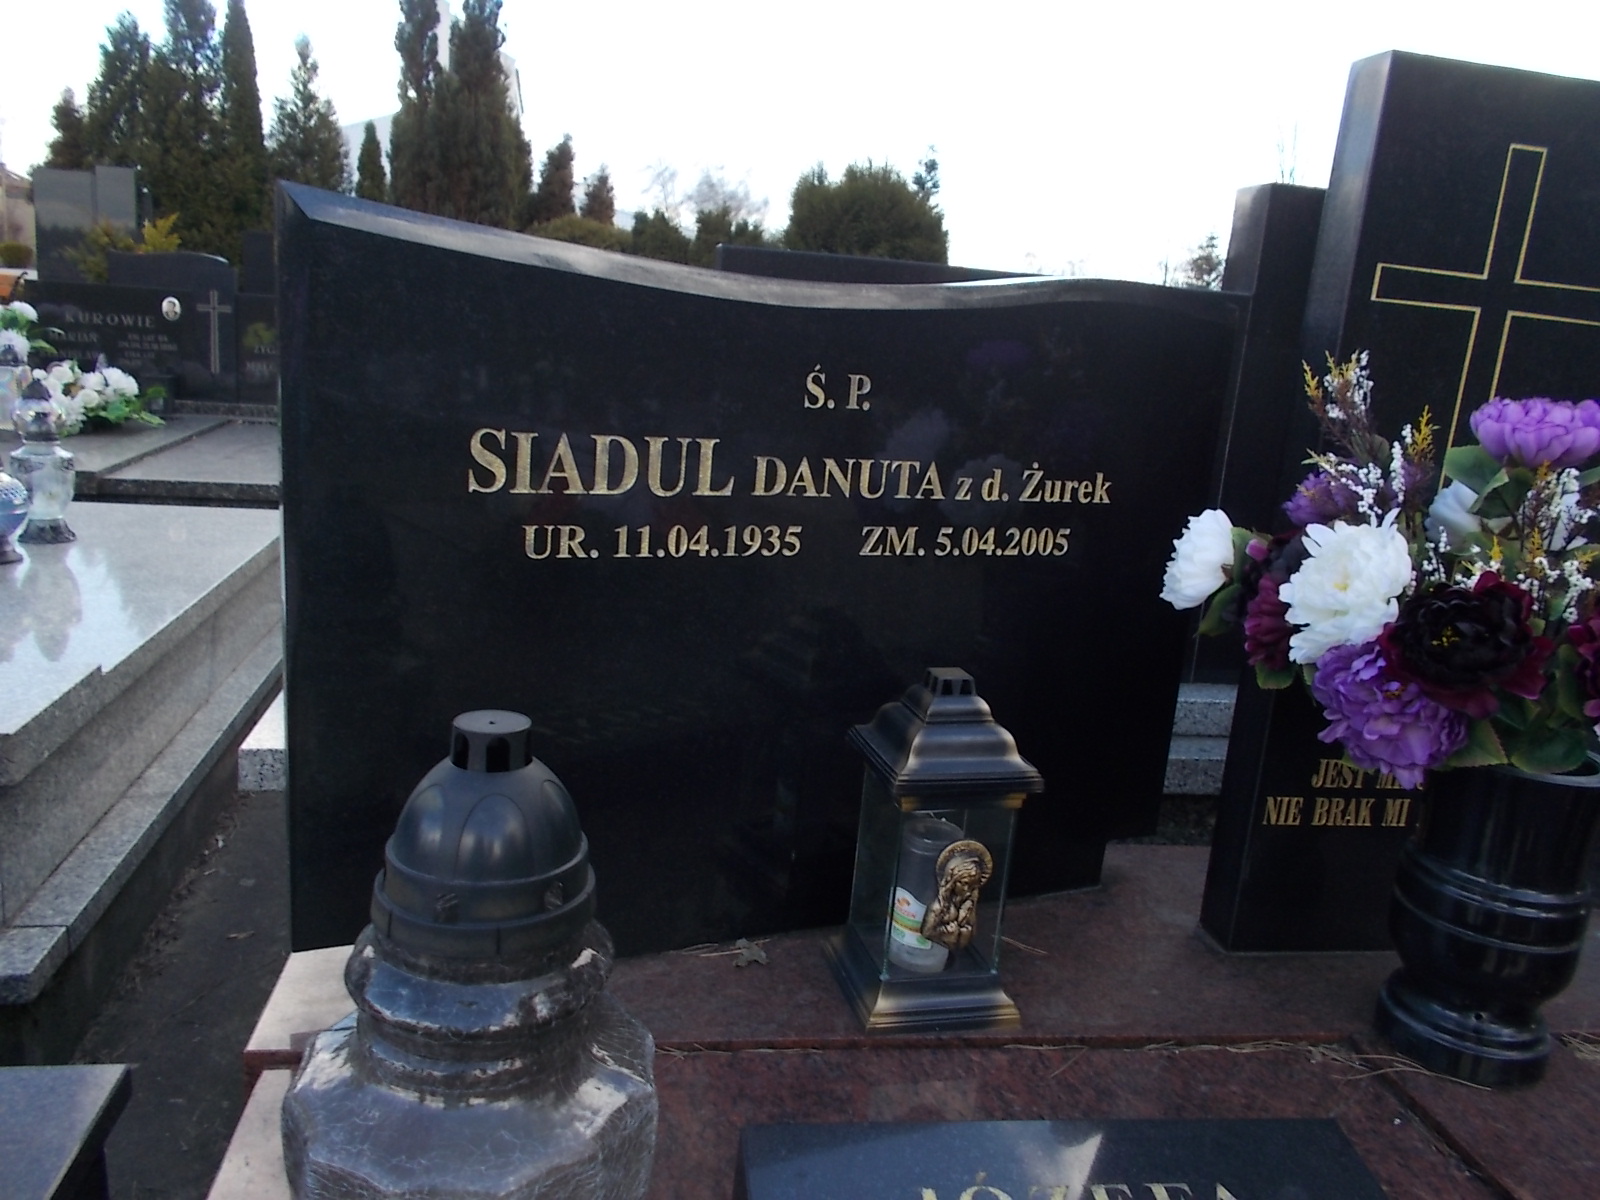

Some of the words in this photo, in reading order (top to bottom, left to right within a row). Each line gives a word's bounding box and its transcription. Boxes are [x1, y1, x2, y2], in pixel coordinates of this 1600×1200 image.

[64, 310, 156, 329] KUROWIE
[803, 363, 835, 410] Ś.
[845, 374, 872, 411] P.
[467, 427, 736, 498] SIADUL
[750, 455, 946, 500] DANUTA
[954, 477, 973, 501] z
[980, 468, 1009, 502] d.
[1018, 461, 1112, 504] Żurek
[521, 524, 600, 560] UR.
[612, 524, 803, 558] 11.04.1935
[858, 526, 926, 557] ZM.
[934, 526, 1071, 557] 5.04.2005
[1311, 758, 1366, 789] JEST
[1262, 796, 1304, 826] NIE
[1311, 797, 1376, 828] BRAK
[1381, 798, 1412, 828] MI
